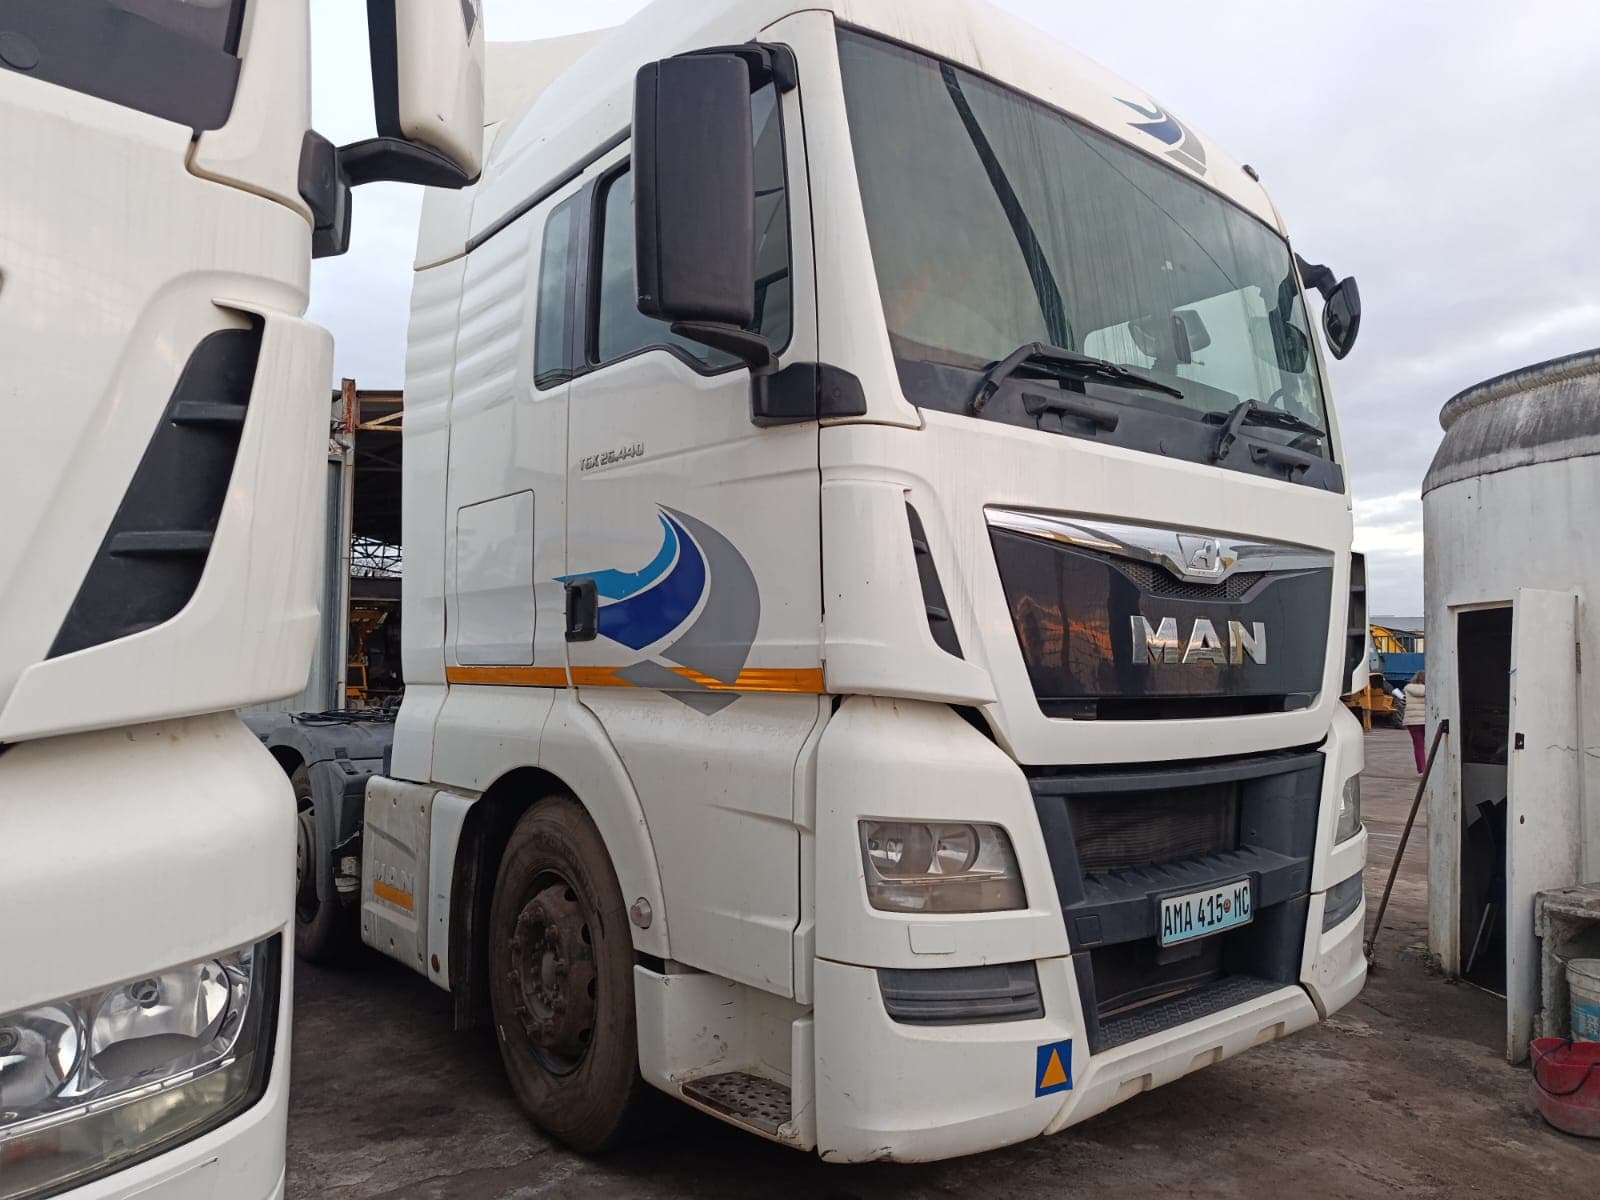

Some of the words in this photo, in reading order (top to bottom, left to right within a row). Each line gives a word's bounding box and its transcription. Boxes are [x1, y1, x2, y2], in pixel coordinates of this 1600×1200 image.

[1130, 615, 1267, 665] MAN
[1164, 901, 1193, 937] AMA
[1198, 893, 1223, 928] 415
[1234, 886, 1249, 918] MC
